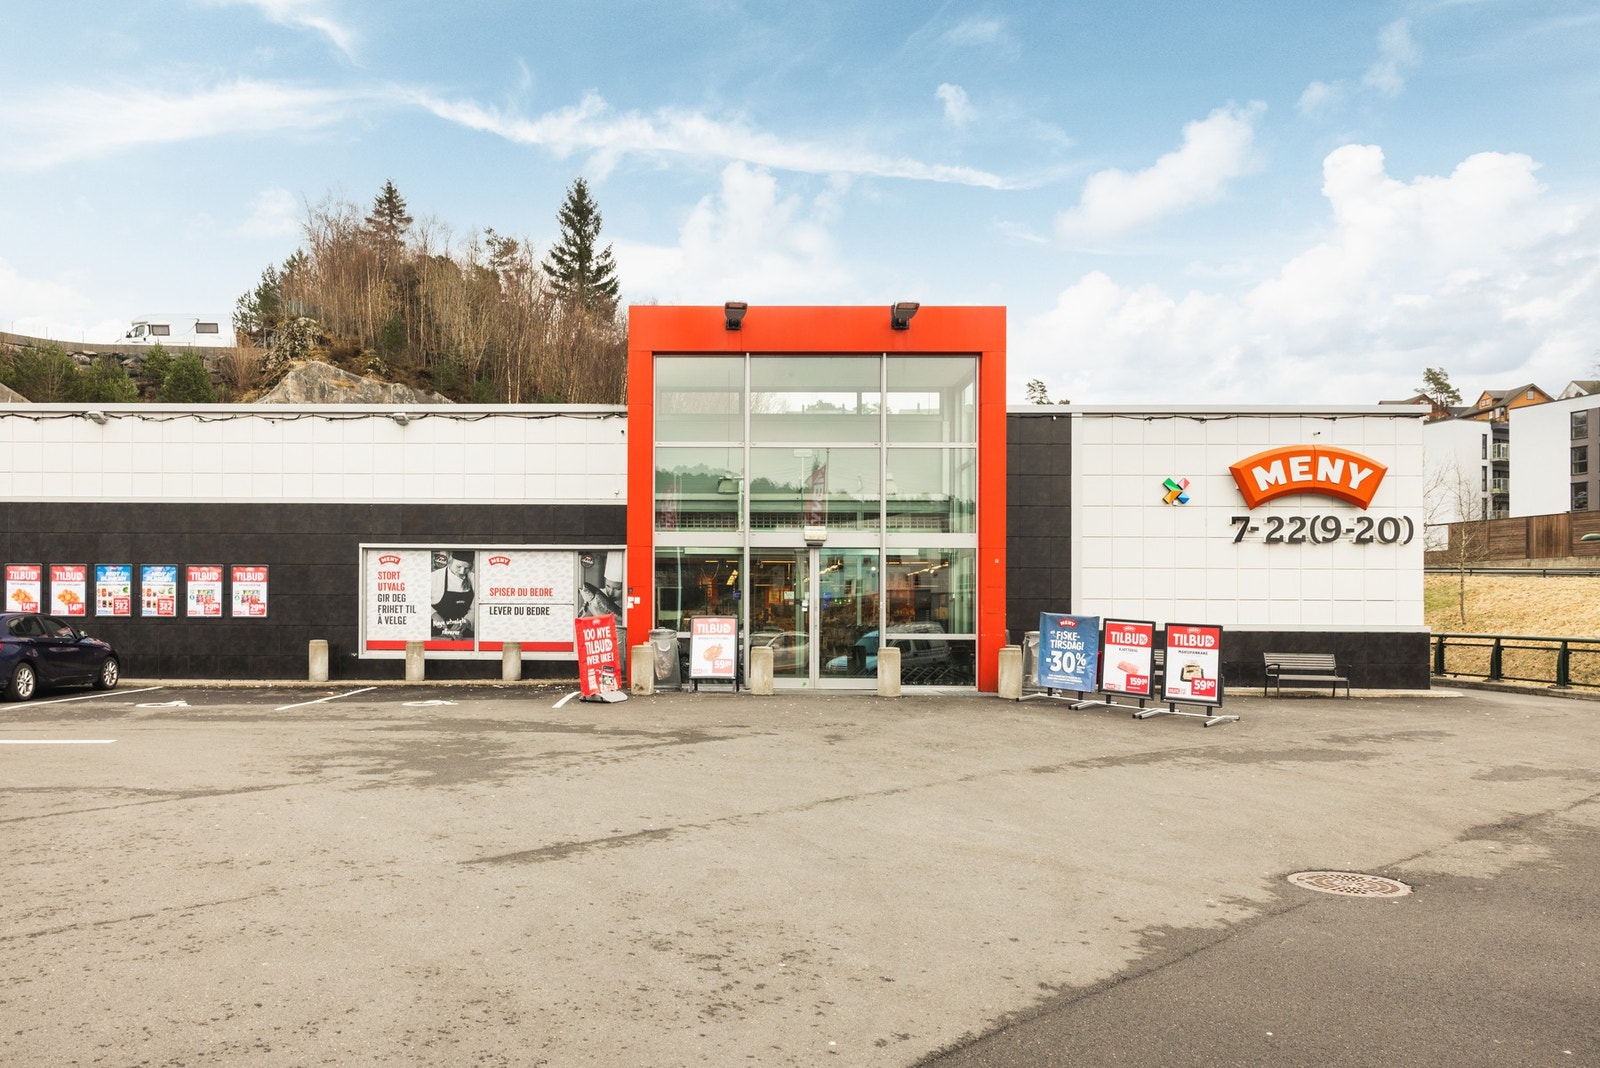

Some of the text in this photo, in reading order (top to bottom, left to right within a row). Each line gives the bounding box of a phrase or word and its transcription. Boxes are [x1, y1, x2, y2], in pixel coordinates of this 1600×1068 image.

[1251, 456, 1374, 491] MENY
[1230, 515, 1415, 545] 7-22(9-20)
[379, 556, 400, 564] MENY
[490, 557, 510, 565] MENY
[10, 571, 38, 580] TILBUD
[55, 572, 83, 581] TILBUD
[191, 572, 219, 581] TILBUD
[236, 572, 265, 581] TILBUD
[378, 571, 401, 580] STORT
[378, 583, 405, 592] UTVALG
[489, 588, 553, 597] SPISER DU BEDRE
[378, 594, 406, 602] GIR DEG
[378, 605, 416, 614] FRIHET TIL
[489, 606, 550, 615] LEVER DU BEDRE
[377, 614, 407, 625] Å VELGE
[583, 626, 611, 640] 100 NYE
[697, 624, 731, 633] TILBUD
[1056, 631, 1080, 641] FISKE-
[1110, 631, 1148, 645] TILBUD
[1173, 633, 1215, 647] TILBUD
[585, 639, 613, 655] TILBUD
[1050, 640, 1084, 650] TIRSDAG!
